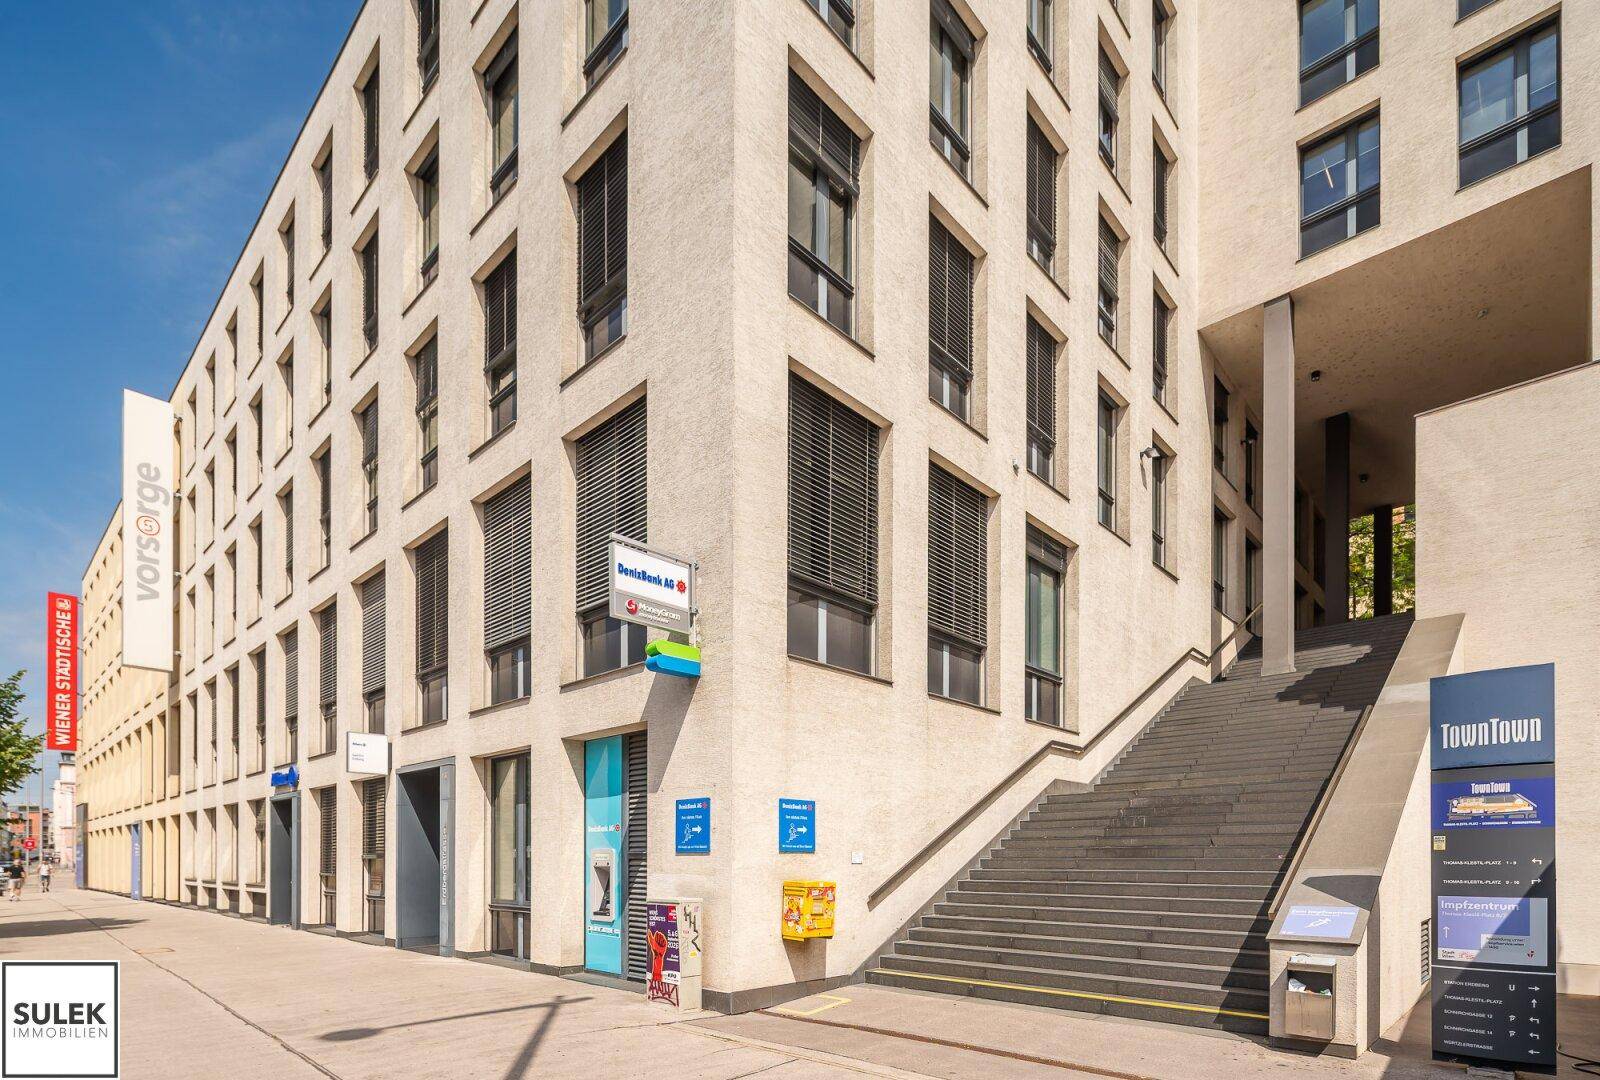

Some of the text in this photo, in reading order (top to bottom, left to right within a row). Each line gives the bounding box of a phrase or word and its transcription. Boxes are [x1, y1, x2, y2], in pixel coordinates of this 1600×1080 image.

[617, 562, 675, 590] DenizBank AG
[638, 602, 681, 620] MoneyGram
[55, 609, 72, 746] WIENER STÄDTISCHE
[1441, 717, 1542, 749] TownTown
[1471, 782, 1511, 794] TownTown
[1441, 900, 1520, 911] Impfzentrum
